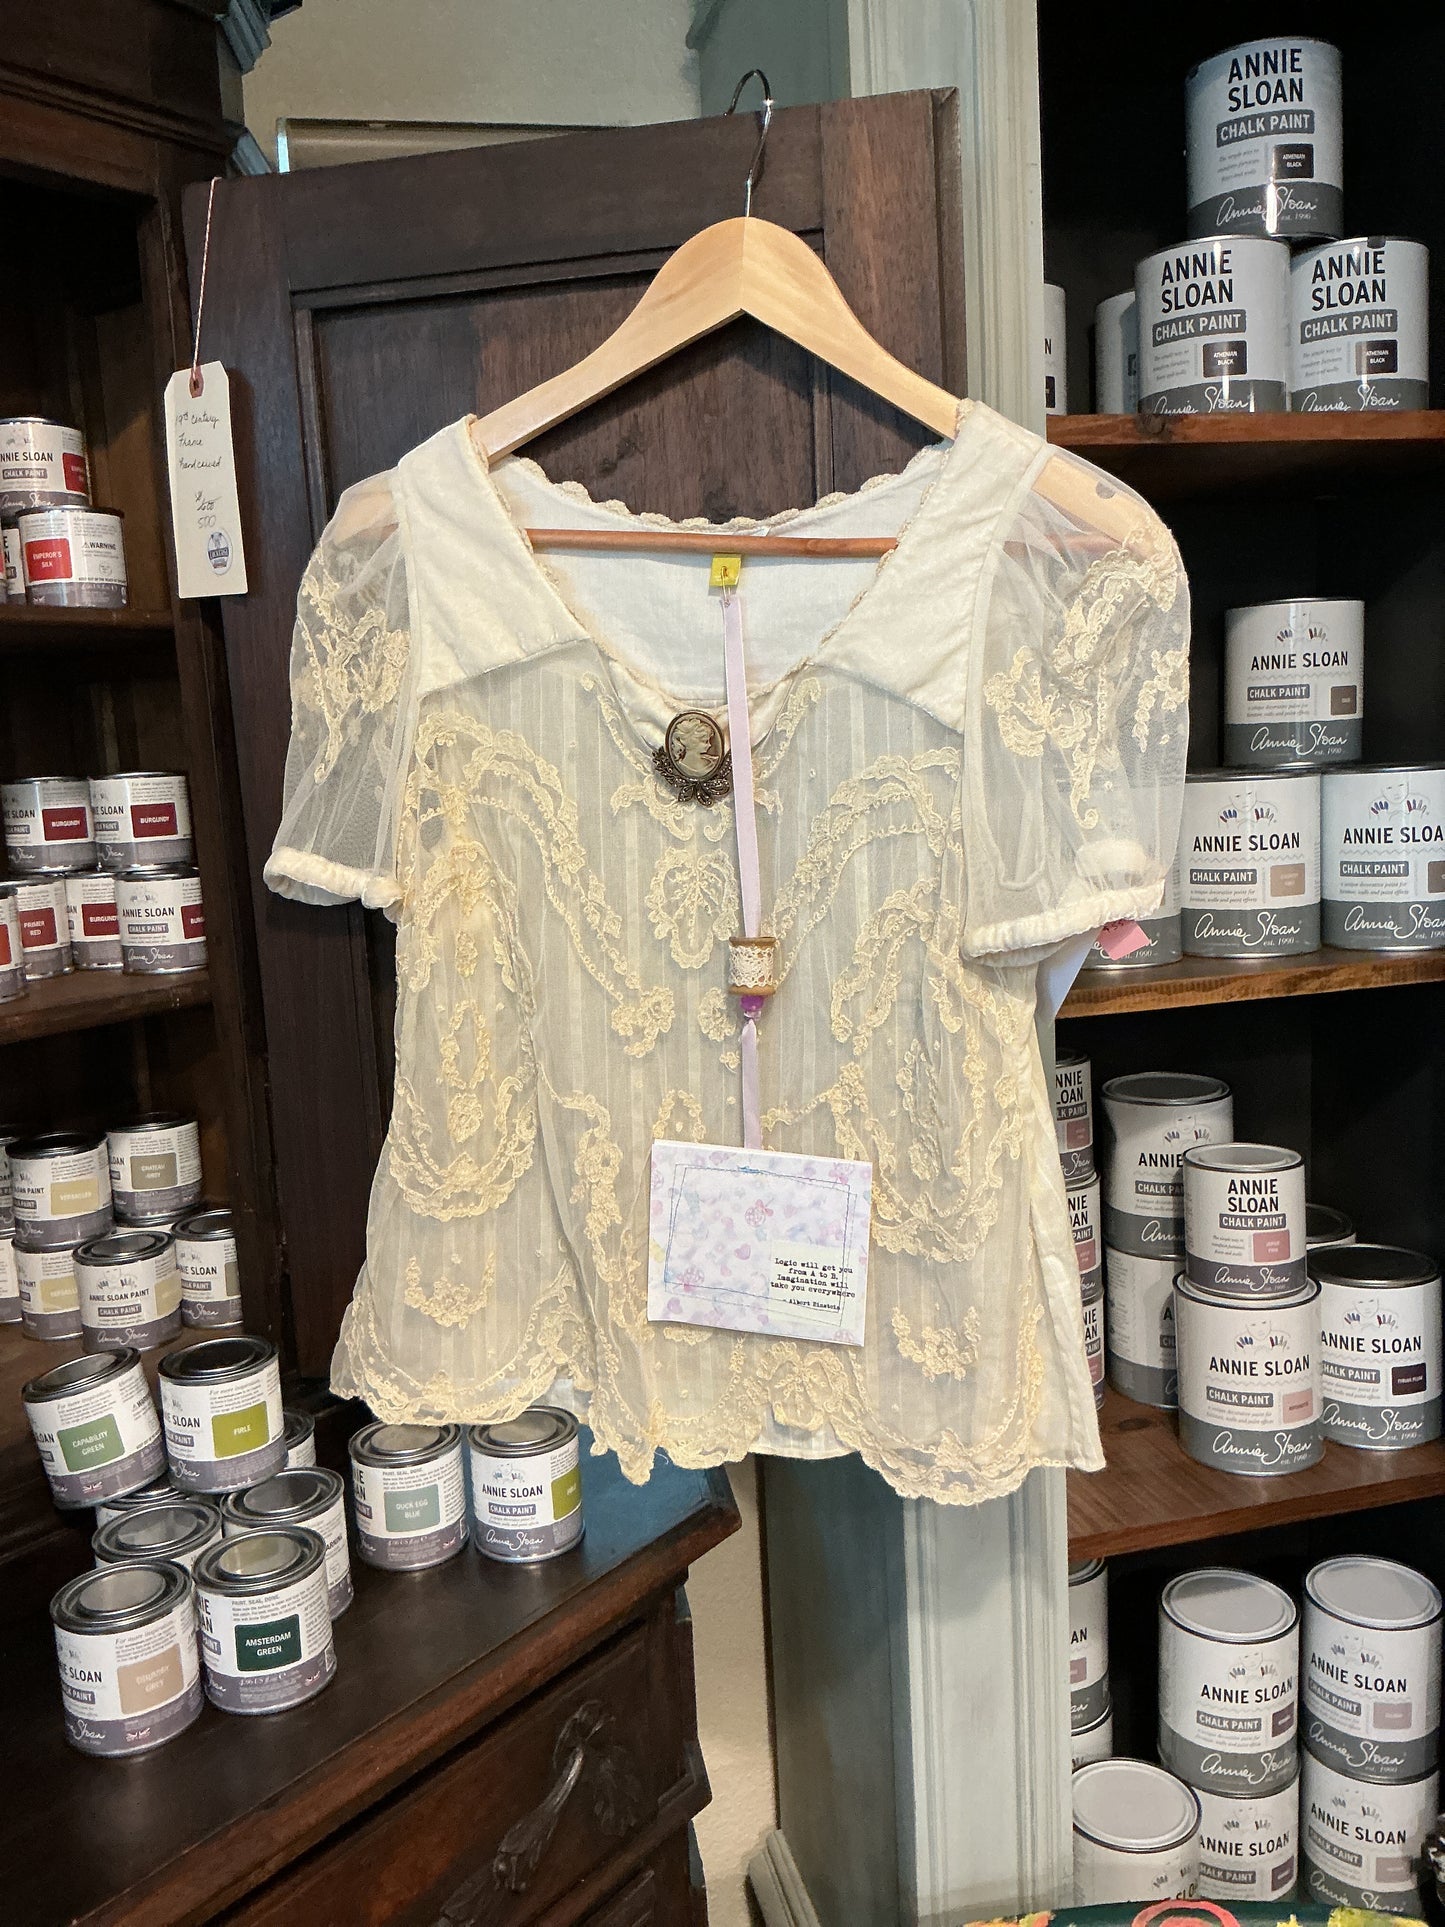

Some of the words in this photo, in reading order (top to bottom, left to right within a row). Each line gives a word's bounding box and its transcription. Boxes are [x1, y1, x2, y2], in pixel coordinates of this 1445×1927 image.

[1228, 48, 1303, 84] ANNIE
[1228, 78, 1303, 112] SLOAN
[1220, 117, 1265, 141] CHALK
[1270, 114, 1310, 131] PAINT
[1161, 250, 1232, 286] ANNIE
[1312, 251, 1385, 284] ANNIE
[1161, 279, 1233, 313] SLOAN
[1312, 279, 1386, 311] SLOAN
[1156, 319, 1195, 341] CHALK
[1200, 314, 1241, 331] PAINT
[1304, 318, 1348, 338] CHALK
[1352, 314, 1393, 329] PAINT
[0, 452, 20, 462] NNIE
[22, 452, 53, 462] SLOAN
[90, 542, 116, 550] WARNING
[1251, 654, 1297, 671] ANNIE
[1303, 651, 1348, 668] SLOAN
[1249, 689, 1276, 698] CHALK
[1279, 686, 1307, 697] PAINT
[1250, 727, 1301, 751] Annie
[1296, 723, 1347, 755] Sloan
[12, 810, 35, 818] SLOAN
[100, 806, 124, 815] SLOAN
[1193, 835, 1242, 852] ANNIE
[1248, 832, 1300, 851] SLOAN
[1343, 827, 1393, 844] ANNIE
[1400, 825, 1445, 844] SLOA
[1192, 872, 1220, 882] CHALK
[1223, 872, 1253, 882] PAINT
[1342, 864, 1371, 874] CHALK
[1374, 864, 1405, 874] PAINT
[123, 909, 142, 917] ANNIE
[145, 907, 174, 917] SLOAN
[1345, 905, 1398, 931] Annie
[1194, 913, 1247, 939] Annie
[1243, 912, 1300, 946] Sloan
[1056, 1070, 1082, 1088] NNIE
[1139, 1153, 1183, 1167] ANNIE
[1138, 1183, 1166, 1193] CHALK
[1228, 1179, 1278, 1195] ANNIE
[1068, 1195, 1087, 1211] NIE
[1228, 1196, 1279, 1213] SLOAN
[1222, 1216, 1254, 1228] CHALK
[1257, 1216, 1283, 1227] PAINT
[775, 1258, 797, 1266] Logic
[191, 1266, 217, 1275] SLOAN
[771, 1281, 788, 1289] take
[808, 1288, 855, 1298] everywhere
[777, 1274, 827, 1286] Imagination
[830, 1281, 848, 1289] will
[107, 1291, 129, 1301] SLOAN
[130, 1288, 150, 1298] PAINT
[121, 1305, 140, 1314] PAINT
[1321, 1330, 1365, 1352] ANNIE
[1371, 1335, 1422, 1354] SLOAN
[1209, 1356, 1259, 1376] ANNIE
[1265, 1354, 1310, 1376] SLOAN
[1323, 1364, 1345, 1377] HALK
[1349, 1369, 1377, 1380] PAINT
[1209, 1389, 1238, 1402] CHALK
[1241, 1395, 1270, 1405] PAINT
[173, 1415, 200, 1428] SLOAN
[233, 1424, 251, 1435] FIRLE
[1367, 1409, 1423, 1439] Sloan
[72, 1431, 108, 1447] CAPABILITY
[174, 1437, 191, 1445] PAINT
[82, 1444, 105, 1455] GREEN
[1213, 1431, 1266, 1456] Annie
[1261, 1433, 1311, 1465] Sloan
[482, 1484, 507, 1497] ANNIE
[511, 1485, 543, 1498] SLOAN
[396, 1501, 413, 1511] DUCK
[415, 1499, 428, 1508] EGG
[490, 1505, 510, 1514] CHALK
[513, 1506, 533, 1514] PAINT
[404, 1510, 421, 1519] BLUE
[245, 1631, 291, 1647] AMSTERDAM
[257, 1646, 282, 1657] GREEN
[70, 1668, 102, 1683] SLOAN
[1310, 1652, 1349, 1685] ANNIE
[1354, 1674, 1408, 1693] SLOAN
[72, 1692, 92, 1702] PAINT
[1201, 1684, 1249, 1704] ANNIE
[1255, 1677, 1293, 1703] SLOAN
[1332, 1695, 1358, 1713] PAINT
[1199, 1715, 1229, 1728] CHALK
[1232, 1718, 1259, 1730] PAINT
[1312, 1803, 1350, 1836] ANNIE
[1355, 1827, 1406, 1844] SLOAN
[1200, 1839, 1244, 1856] ANNIE
[1249, 1831, 1290, 1856] SLOAN
[1226, 1870, 1253, 1882] PAINT
